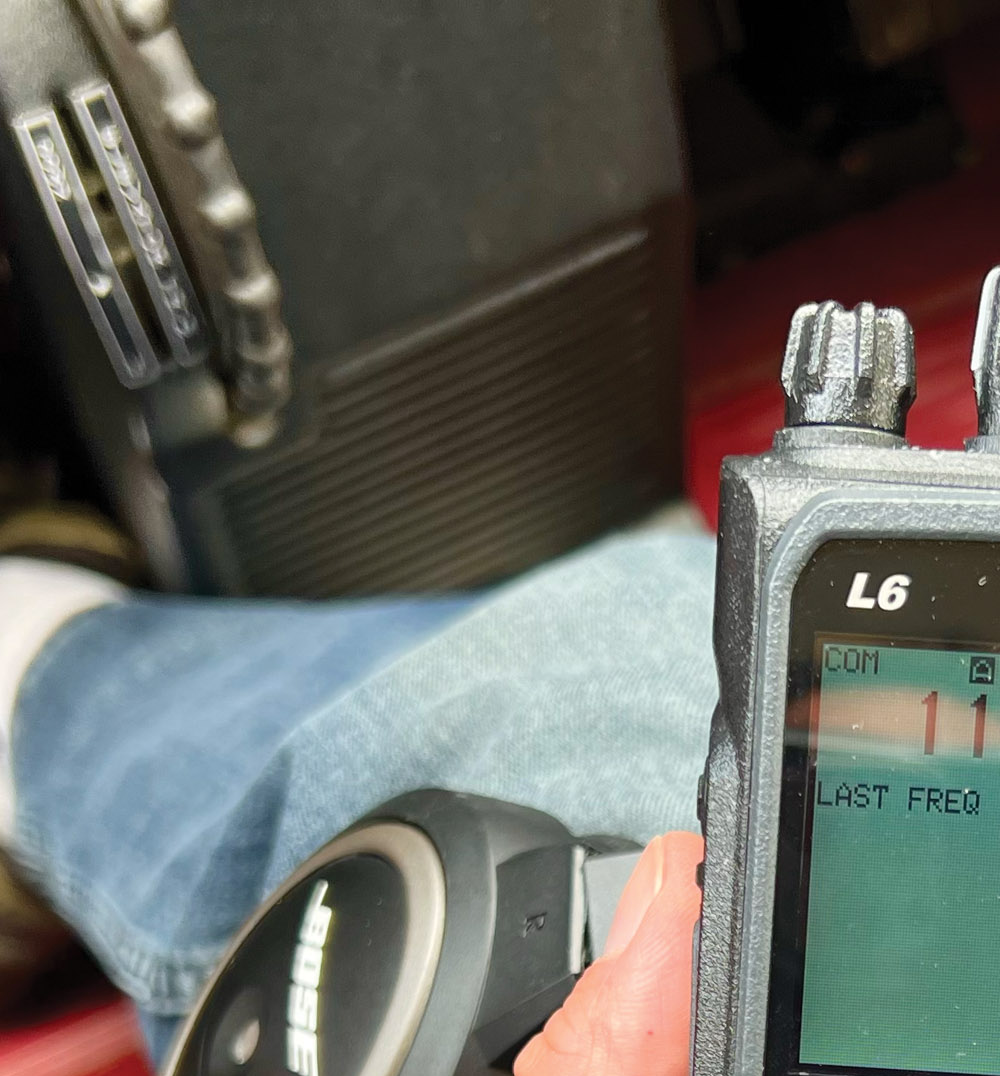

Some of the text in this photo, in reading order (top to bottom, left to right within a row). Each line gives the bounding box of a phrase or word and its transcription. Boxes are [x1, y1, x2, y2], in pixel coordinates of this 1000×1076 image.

[846, 571, 911, 611] L6
[823, 647, 880, 675] COM
[816, 781, 889, 808] LAST
[908, 787, 981, 816] FREQ
